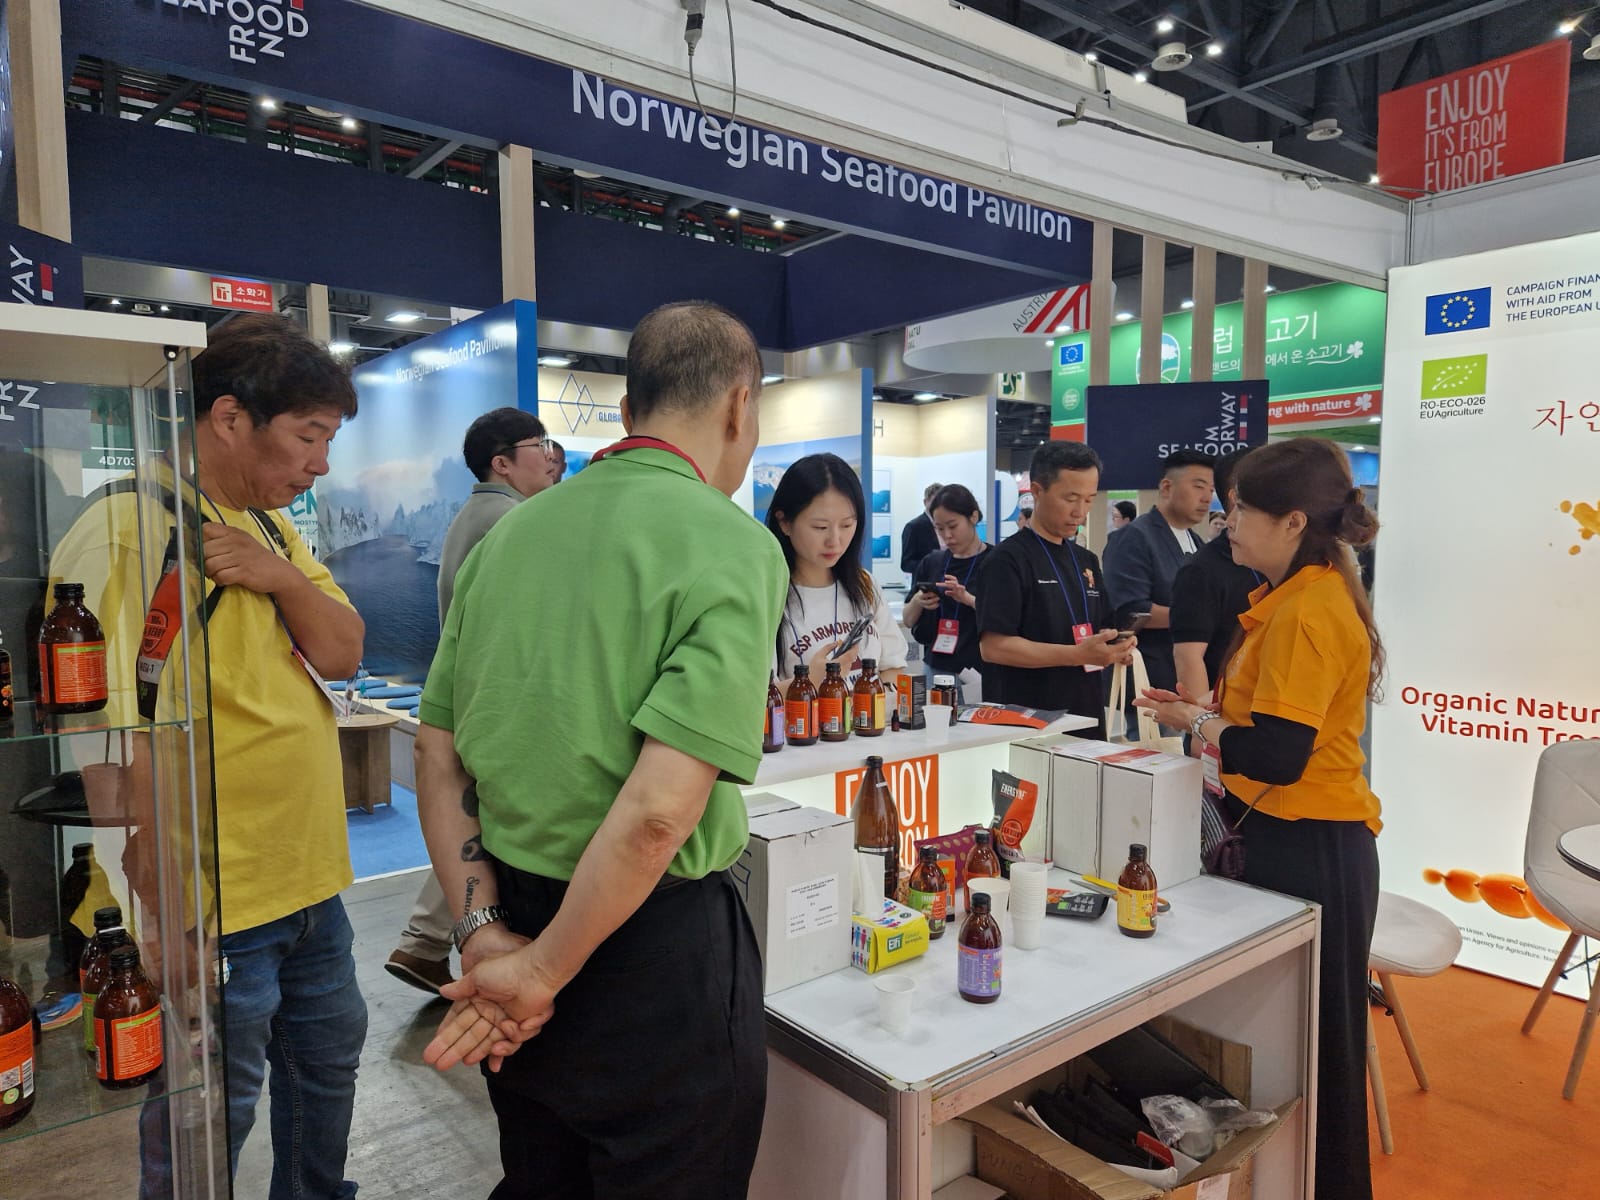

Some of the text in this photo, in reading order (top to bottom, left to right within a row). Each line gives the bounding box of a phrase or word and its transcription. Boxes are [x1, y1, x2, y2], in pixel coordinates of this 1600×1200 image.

[1425, 64, 1511, 131] ENJOY
[1424, 111, 1507, 161] IT'S FROM
[572, 69, 1072, 243] Norwegian Seafood Pavilion
[1424, 143, 1507, 197] EUROPE
[1506, 279, 1565, 296] CAMPAIGN
[1506, 289, 1592, 309] WITH AID FROM
[1506, 311, 1527, 322] THE
[1530, 302, 1593, 320] EUROPEAN
[1305, 343, 1343, 360] 소고기
[1284, 402, 1310, 415] with
[1312, 399, 1351, 413] nature
[1420, 397, 1486, 410] RO-ECO-026
[1401, 686, 1508, 715] Organic
[1421, 713, 1600, 747] Vitamin Tr
